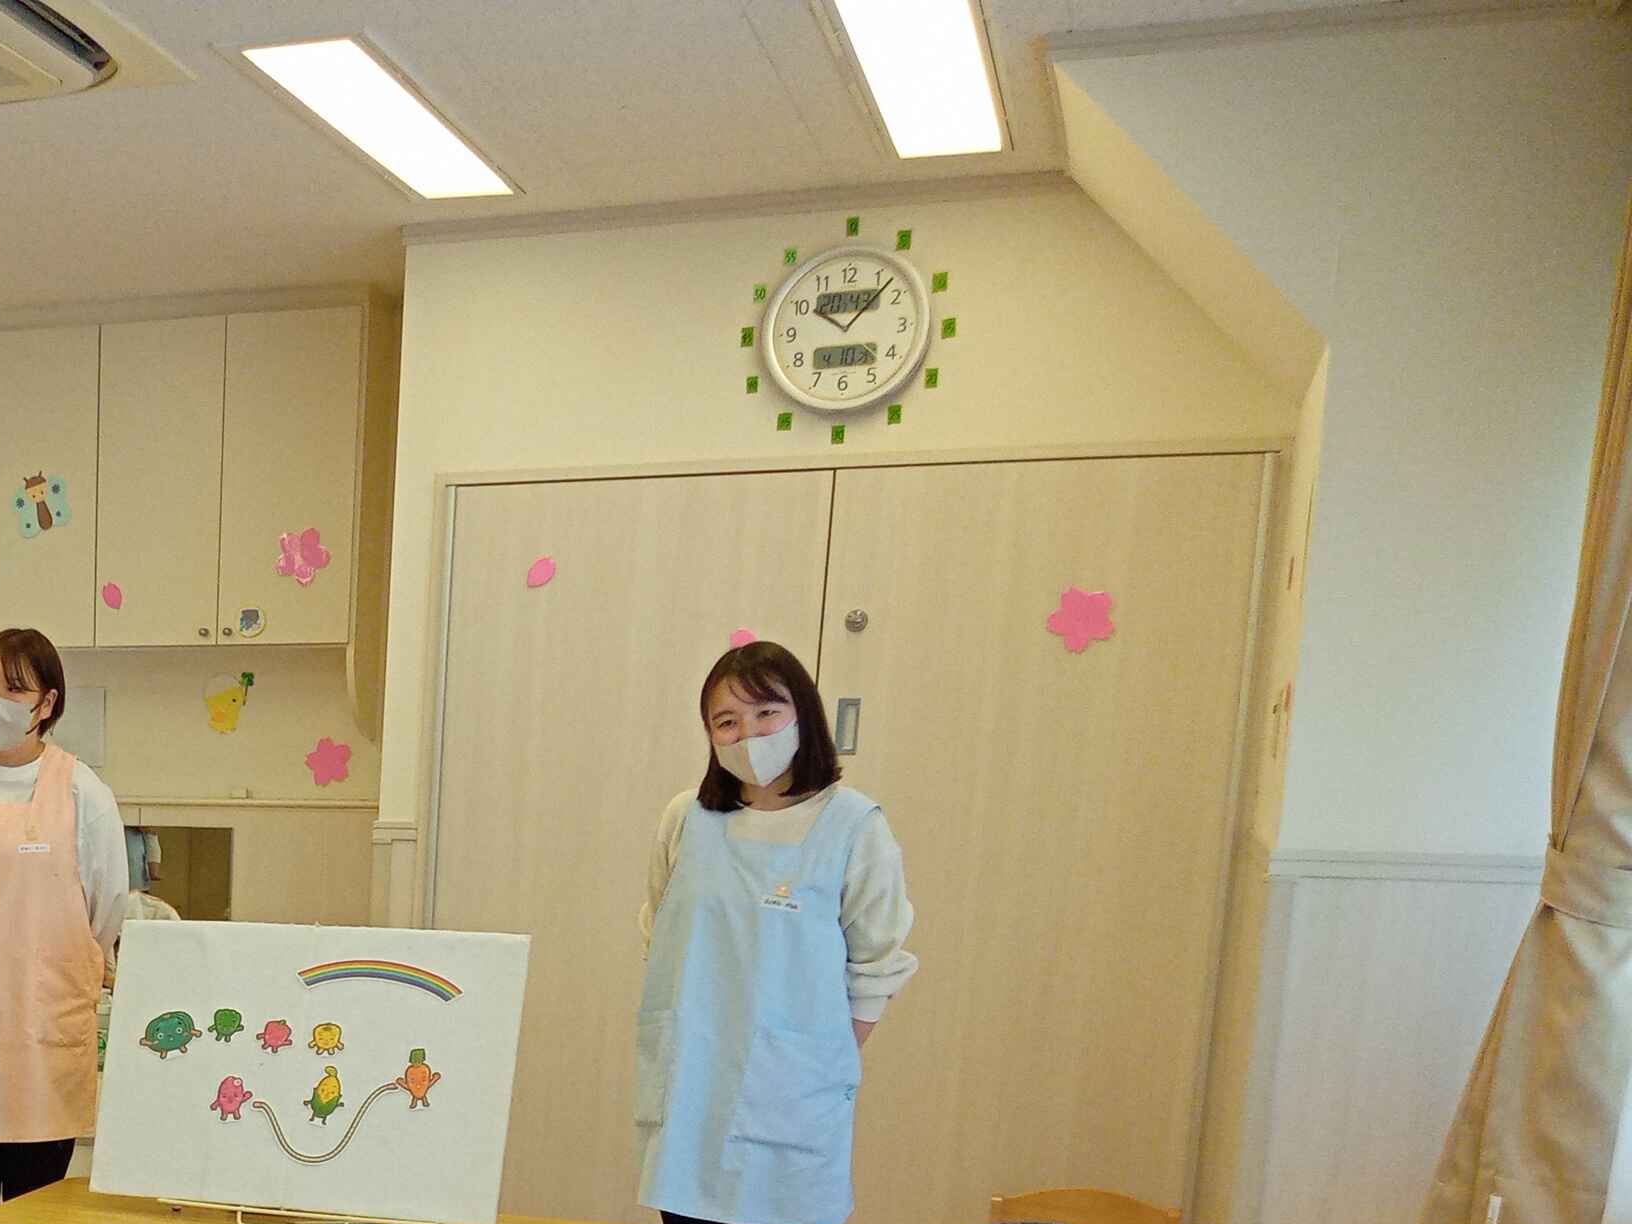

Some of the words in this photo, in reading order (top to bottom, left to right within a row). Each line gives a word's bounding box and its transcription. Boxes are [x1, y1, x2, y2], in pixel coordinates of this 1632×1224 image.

[815, 275, 829, 292] 11
[841, 266, 857, 284] 12
[891, 289, 902, 305] 2
[794, 299, 809, 316] 10
[896, 317, 907, 334] 3
[786, 327, 797, 343] 9
[793, 351, 804, 368] 8
[885, 344, 897, 360] 4
[812, 371, 822, 388] 7
[837, 375, 848, 391] 6
[866, 367, 877, 384] 5
